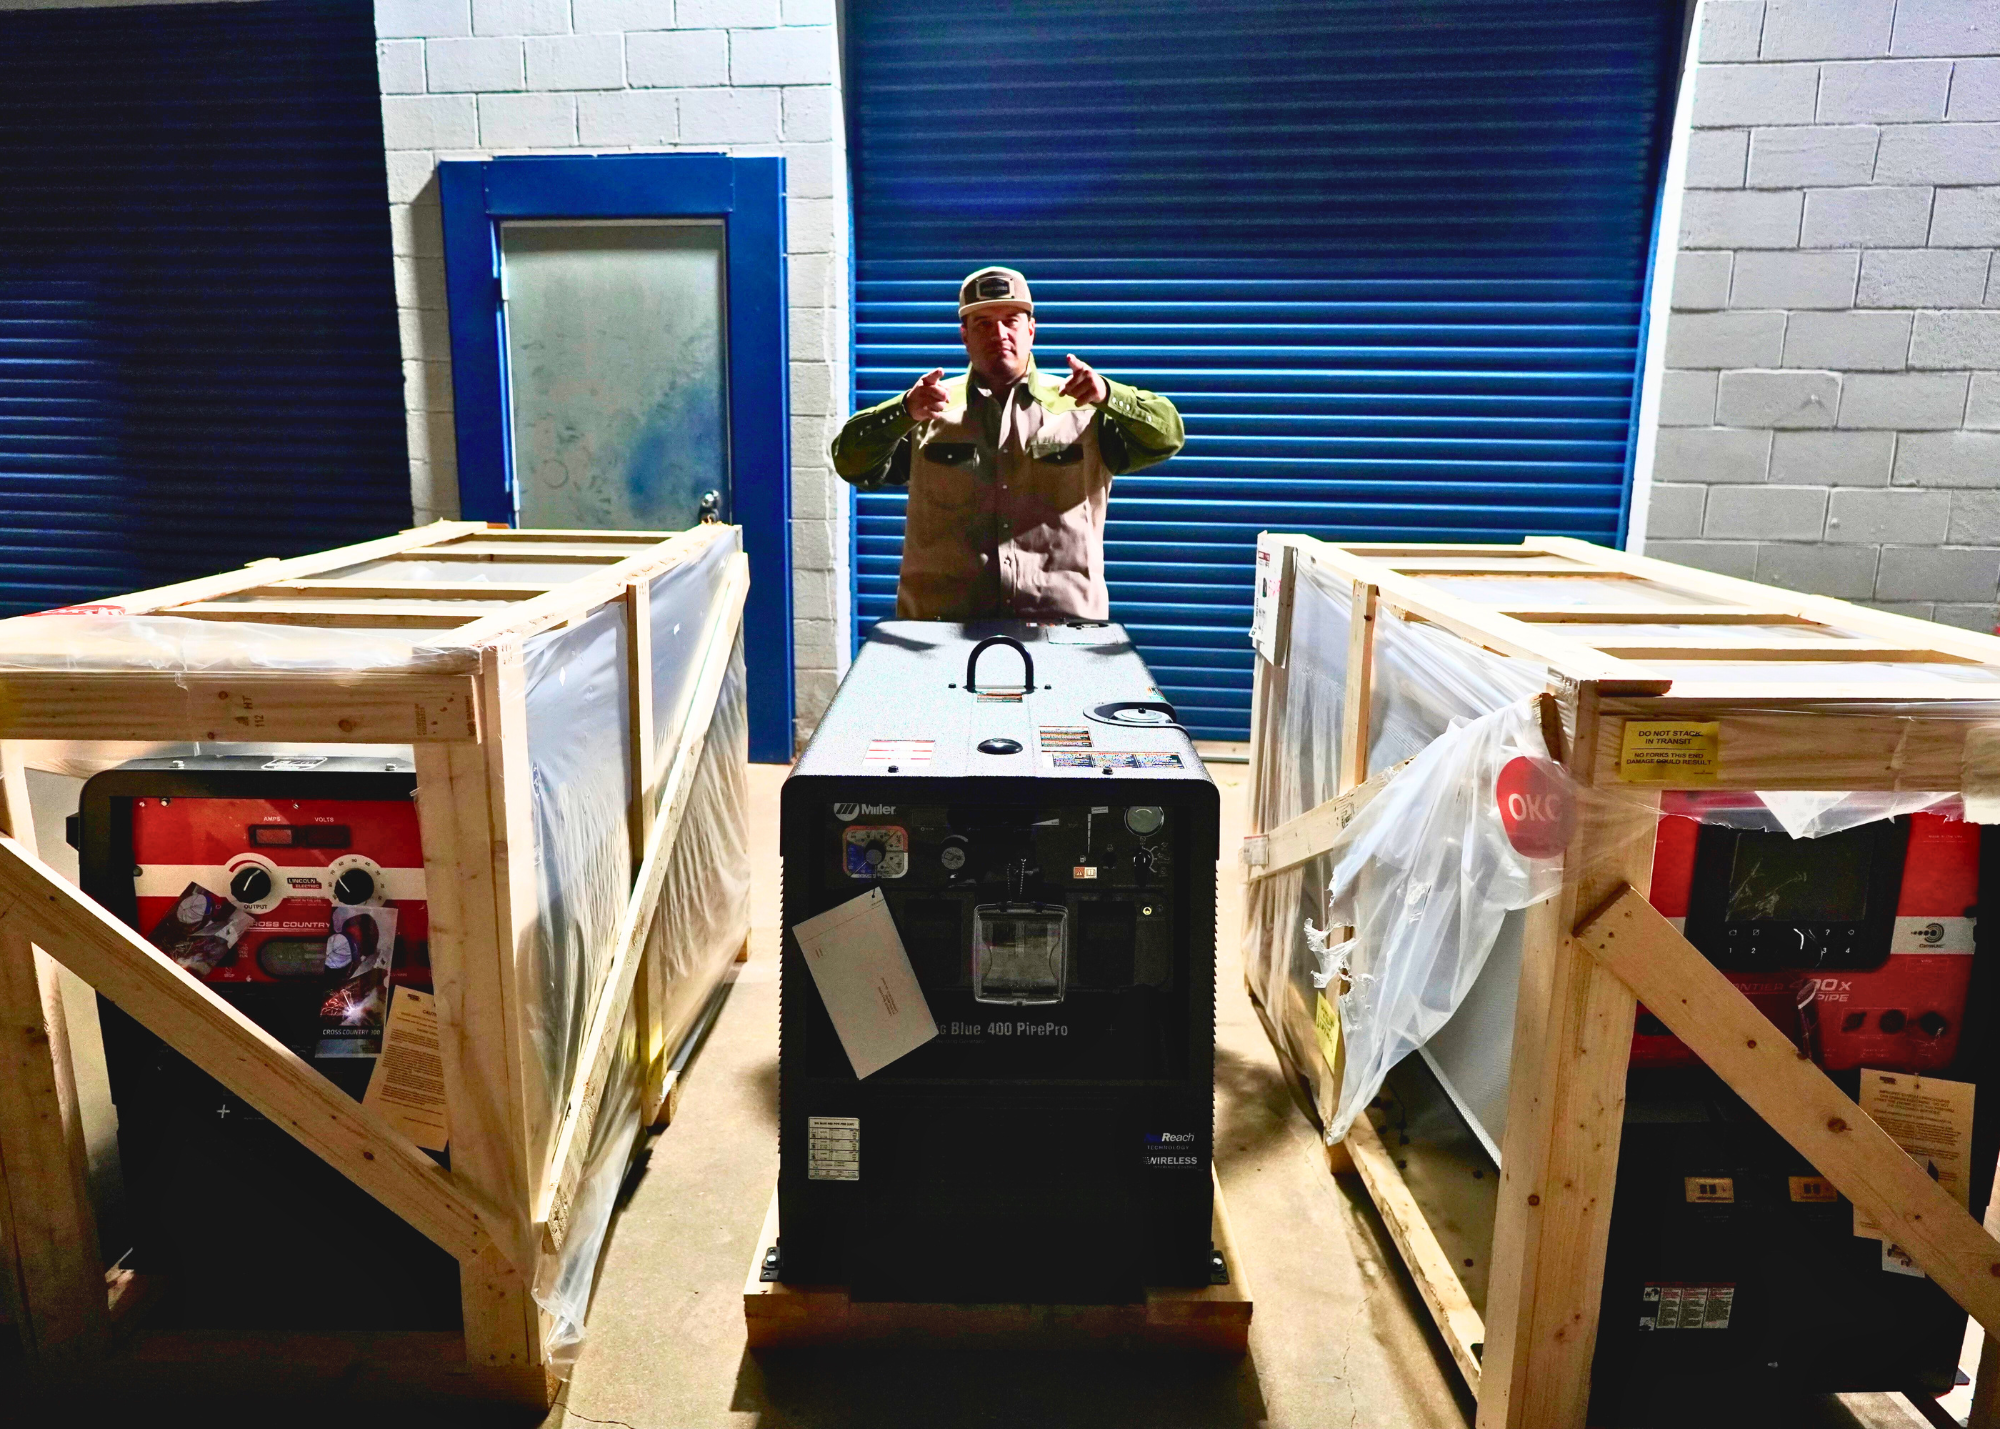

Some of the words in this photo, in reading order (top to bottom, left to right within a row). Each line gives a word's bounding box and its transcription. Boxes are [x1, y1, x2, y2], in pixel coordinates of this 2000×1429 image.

[861, 803, 897, 815] Miller
[950, 1022, 981, 1036] Blue
[987, 1022, 1013, 1036] 400
[1149, 1156, 1198, 1165] WIRELESS
